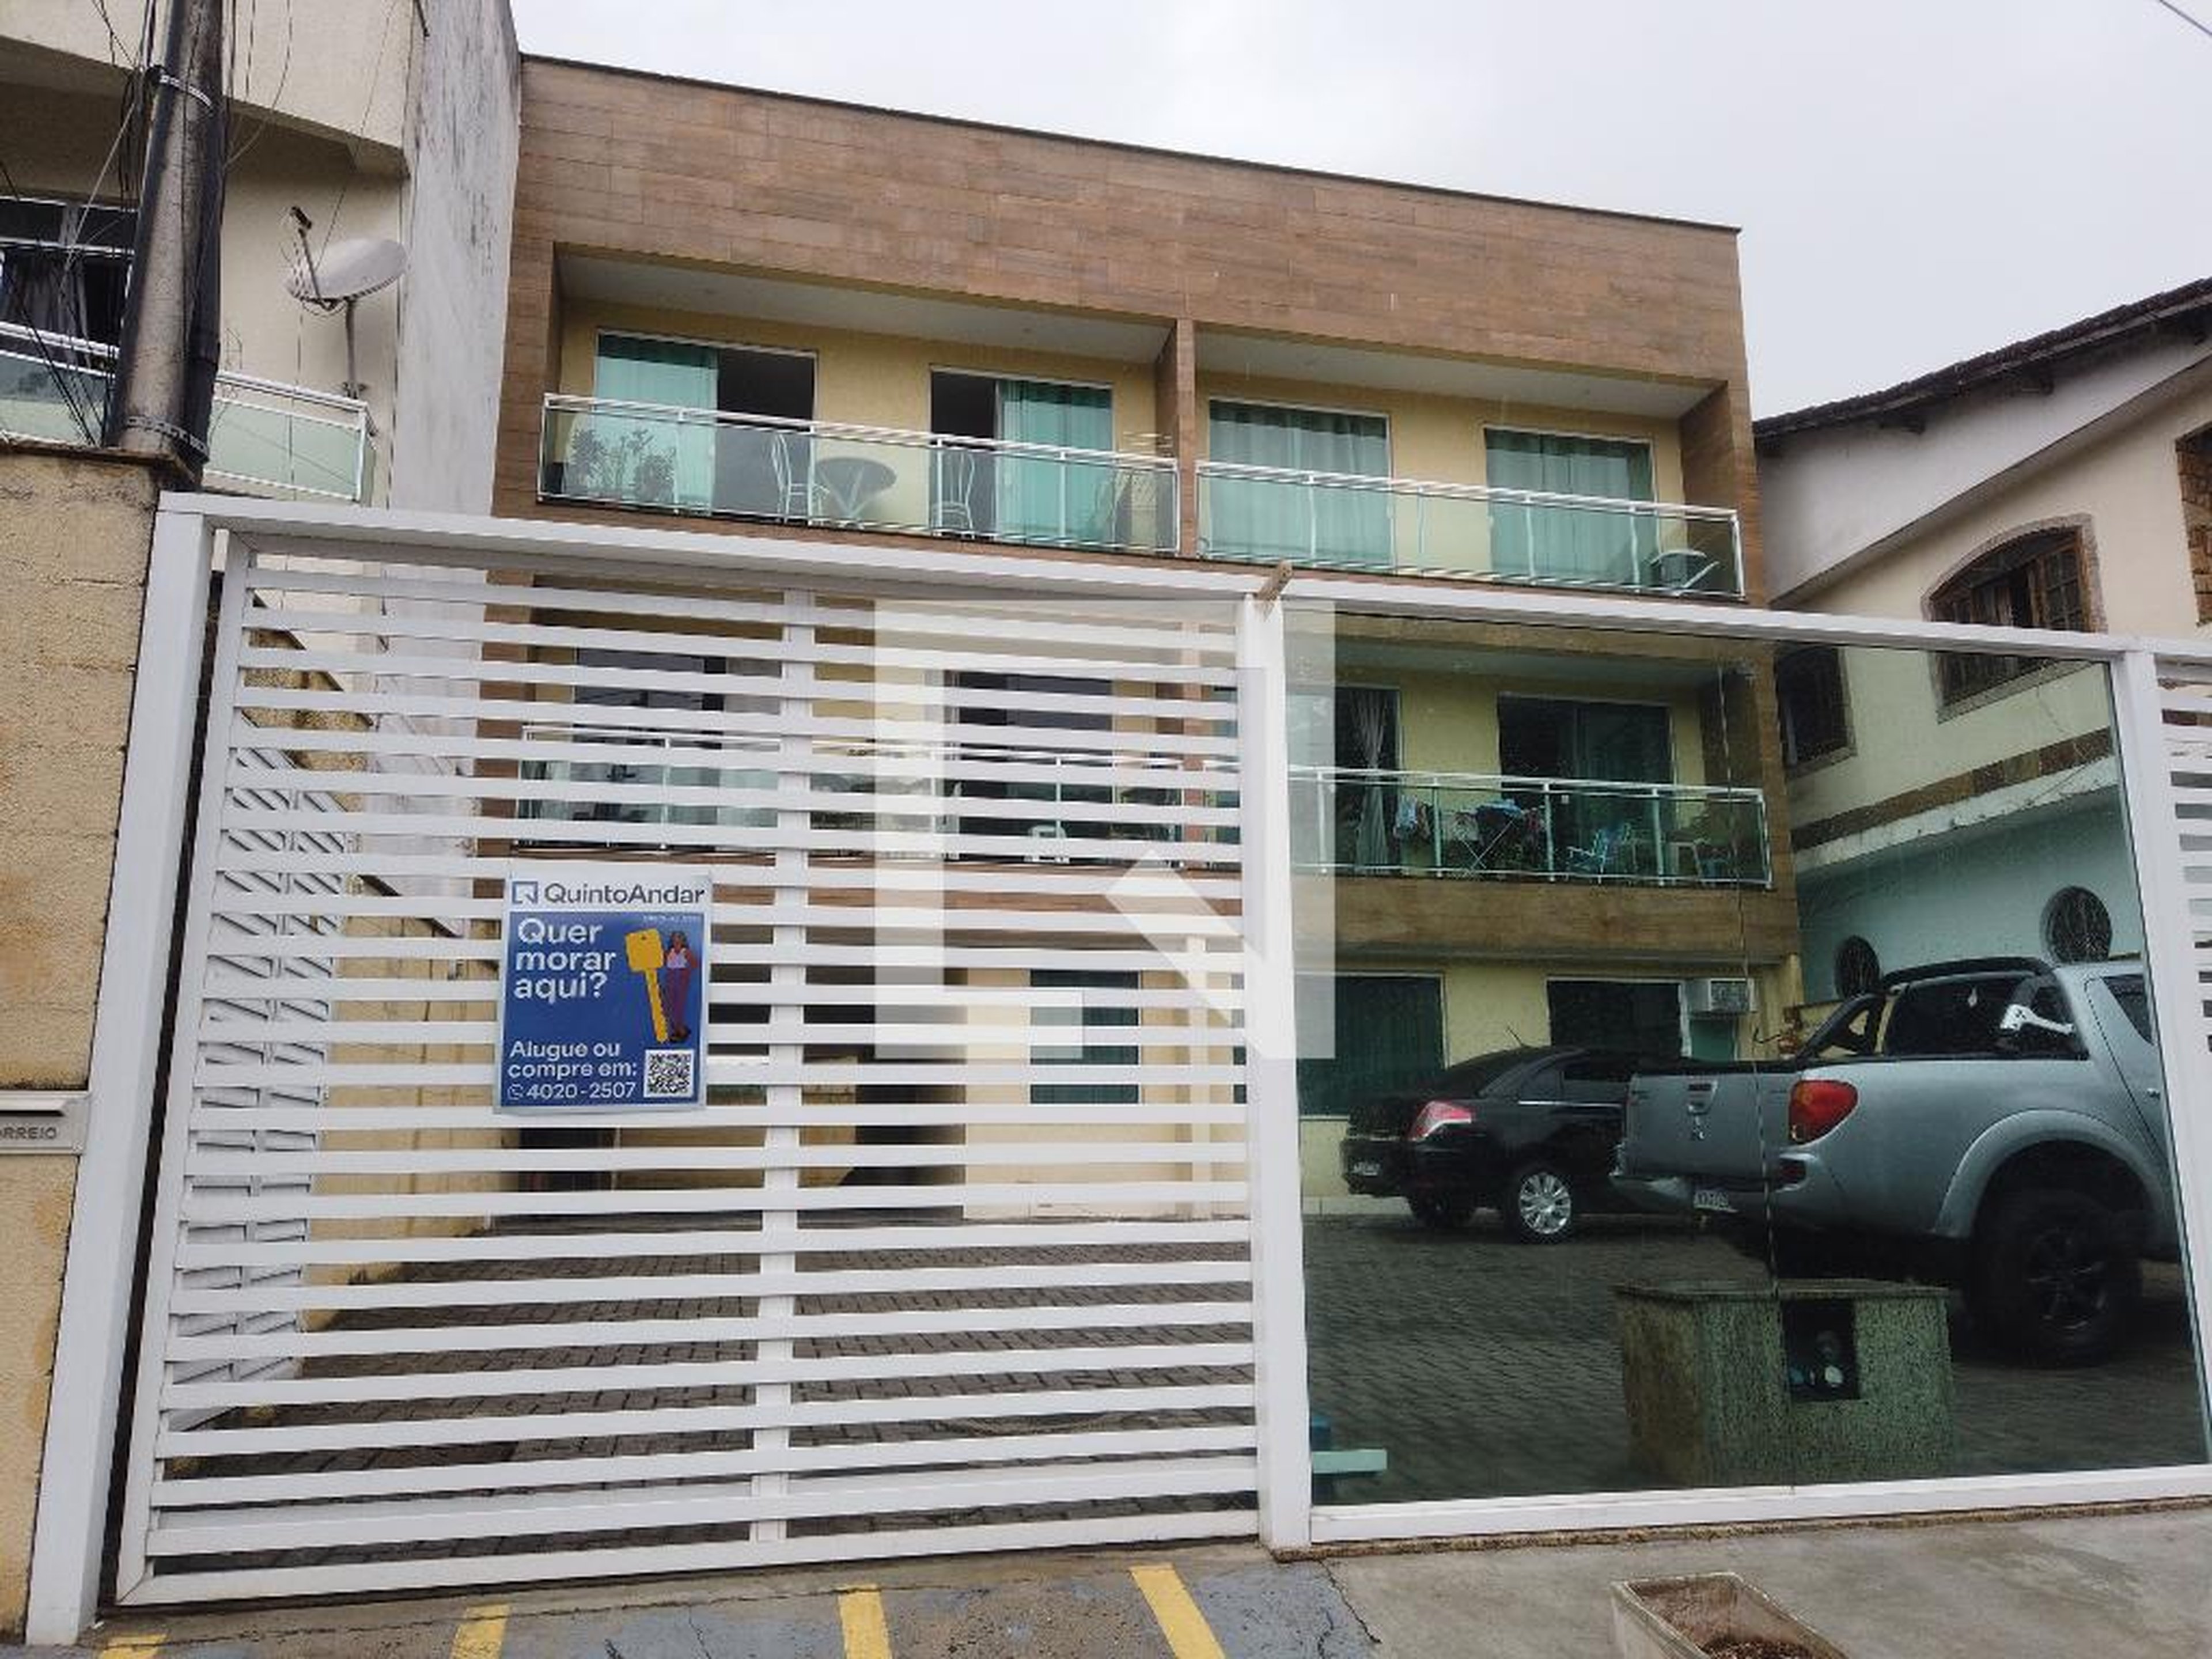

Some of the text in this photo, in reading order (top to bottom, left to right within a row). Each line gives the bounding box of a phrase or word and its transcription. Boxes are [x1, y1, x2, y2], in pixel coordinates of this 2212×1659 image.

[544, 883, 704, 903] QuintoAndar
[518, 918, 603, 945] Quer
[516, 951, 616, 970] morar
[513, 971, 607, 1003] aqui?
[509, 1040, 620, 1061] Alugue ou
[507, 1062, 637, 1080] compre em:
[0, 1126, 56, 1139] RREIO
